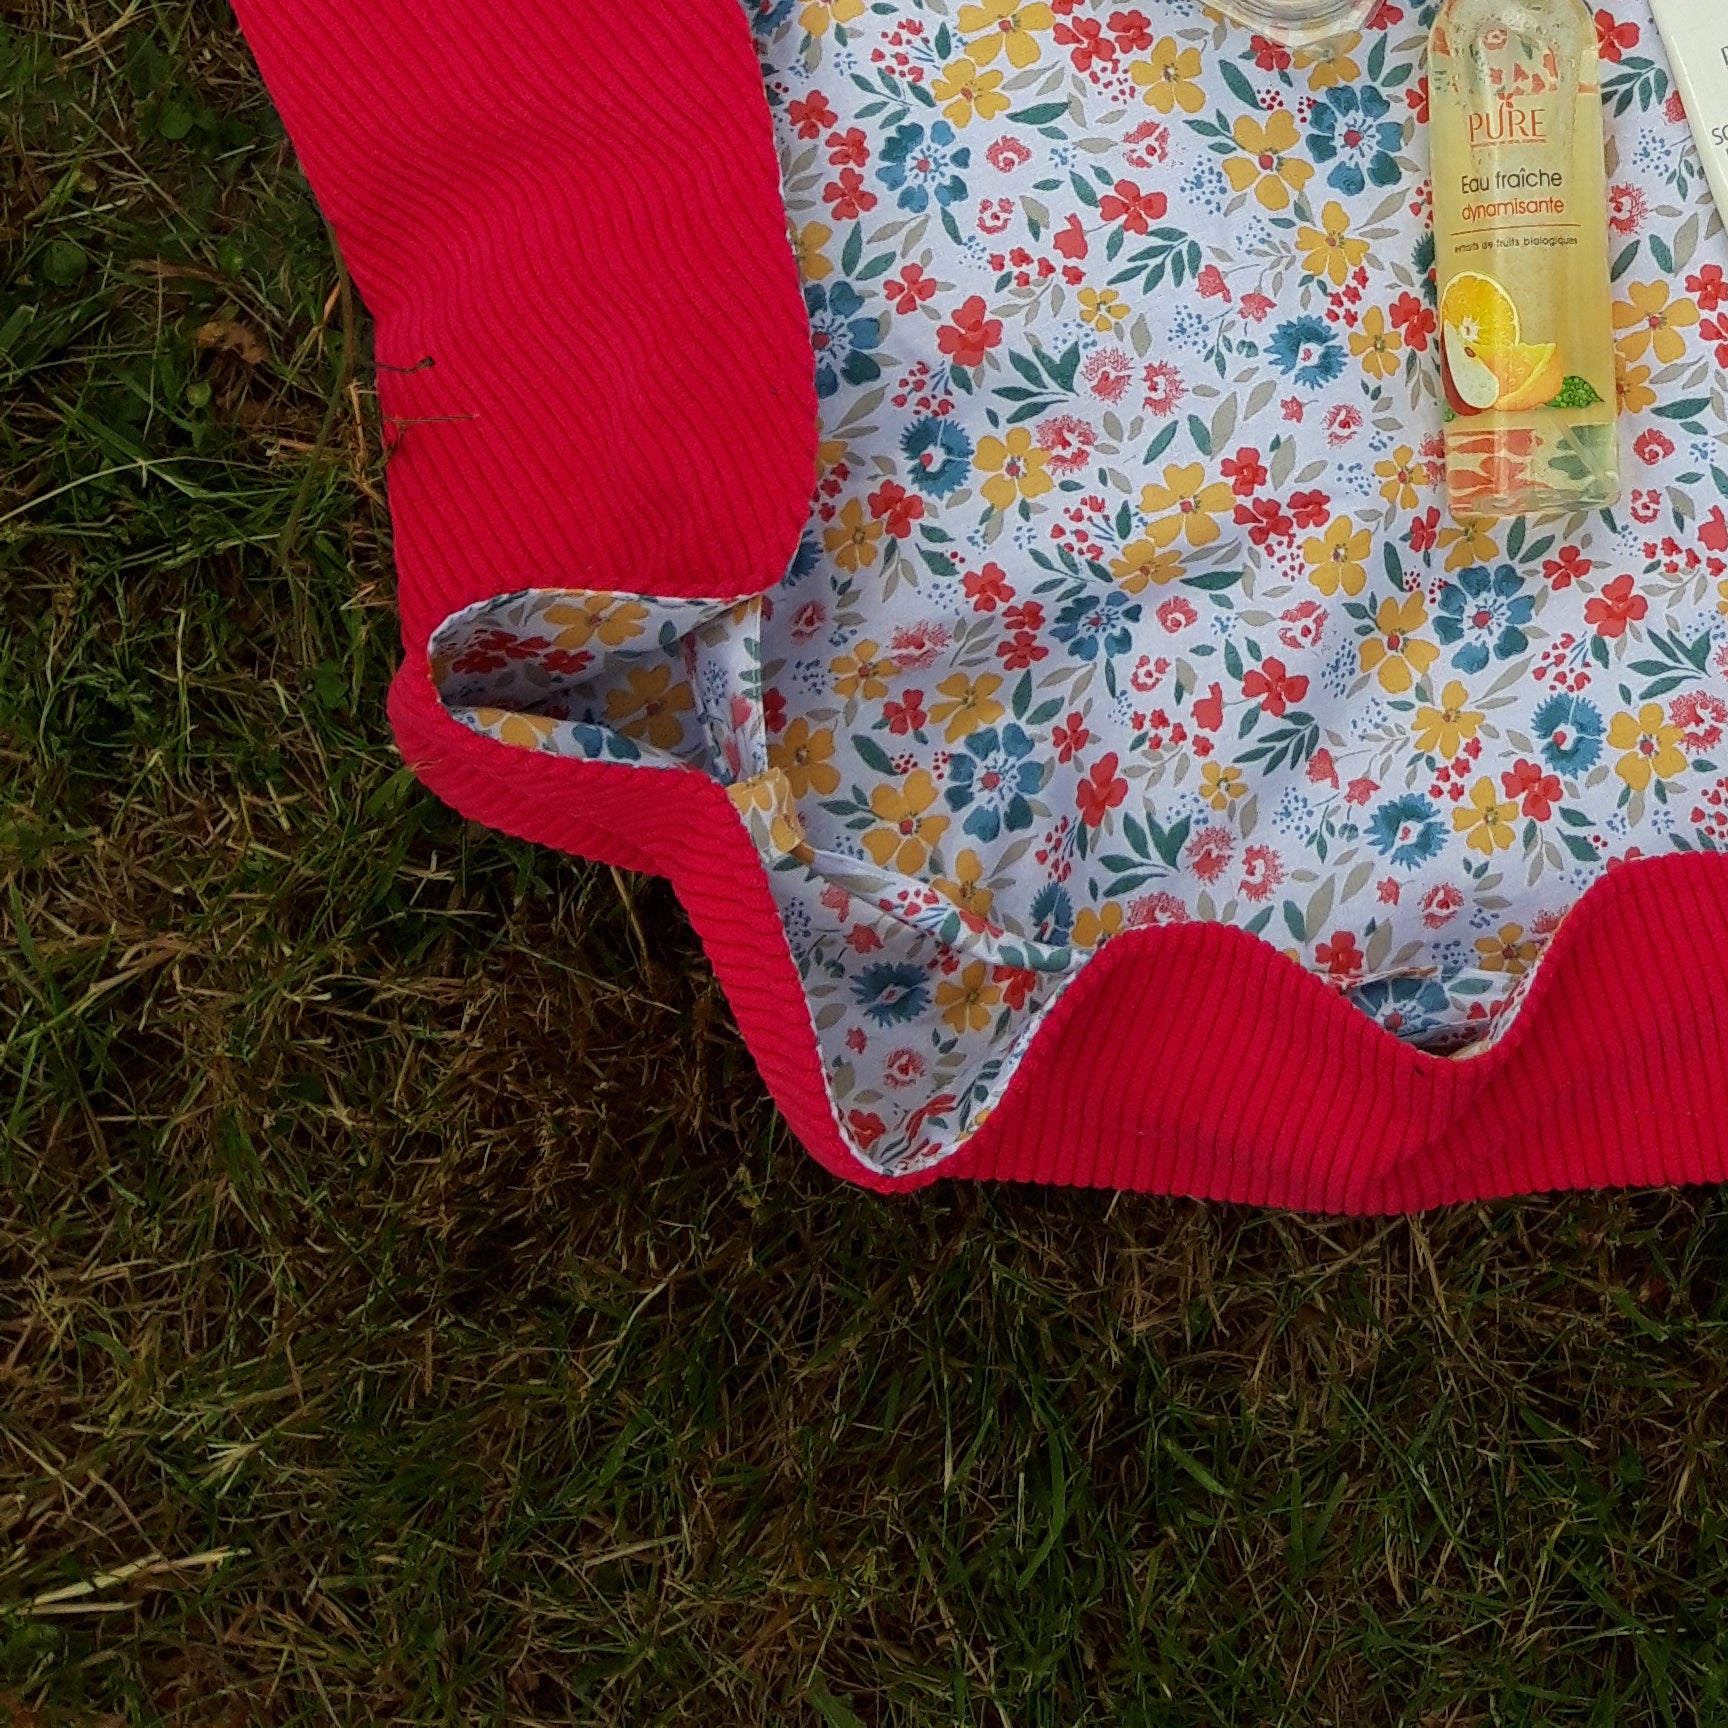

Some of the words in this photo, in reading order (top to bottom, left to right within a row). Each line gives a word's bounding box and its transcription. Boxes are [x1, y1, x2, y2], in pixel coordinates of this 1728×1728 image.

[1468, 101, 1547, 142] PURE
[1461, 174, 1490, 194] Eau
[1495, 167, 1563, 190] fraîche
[1461, 197, 1565, 224] dynamisante
[1523, 235, 1578, 249] biologiques
